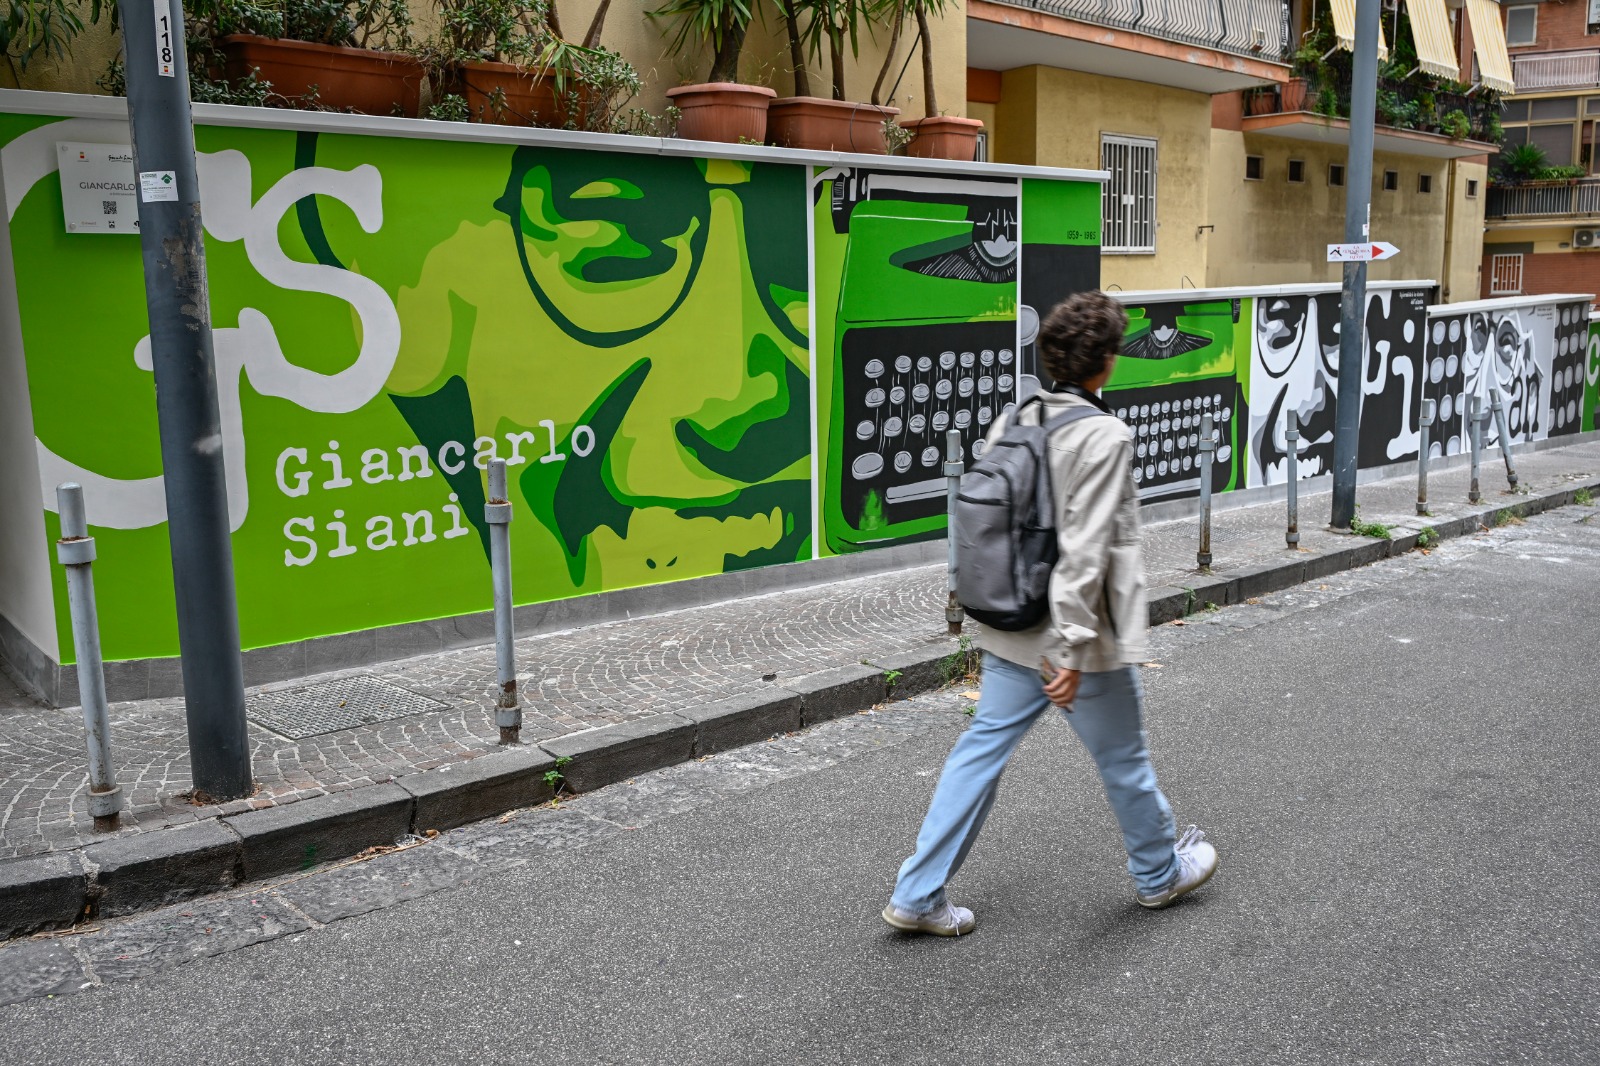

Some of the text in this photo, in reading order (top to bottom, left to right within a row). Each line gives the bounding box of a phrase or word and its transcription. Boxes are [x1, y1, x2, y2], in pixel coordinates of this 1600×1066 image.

[160, 15, 172, 63] 118
[79, 181, 136, 191] GIANCARLO
[275, 419, 595, 498] Giancarlo
[283, 493, 469, 567] Siani
